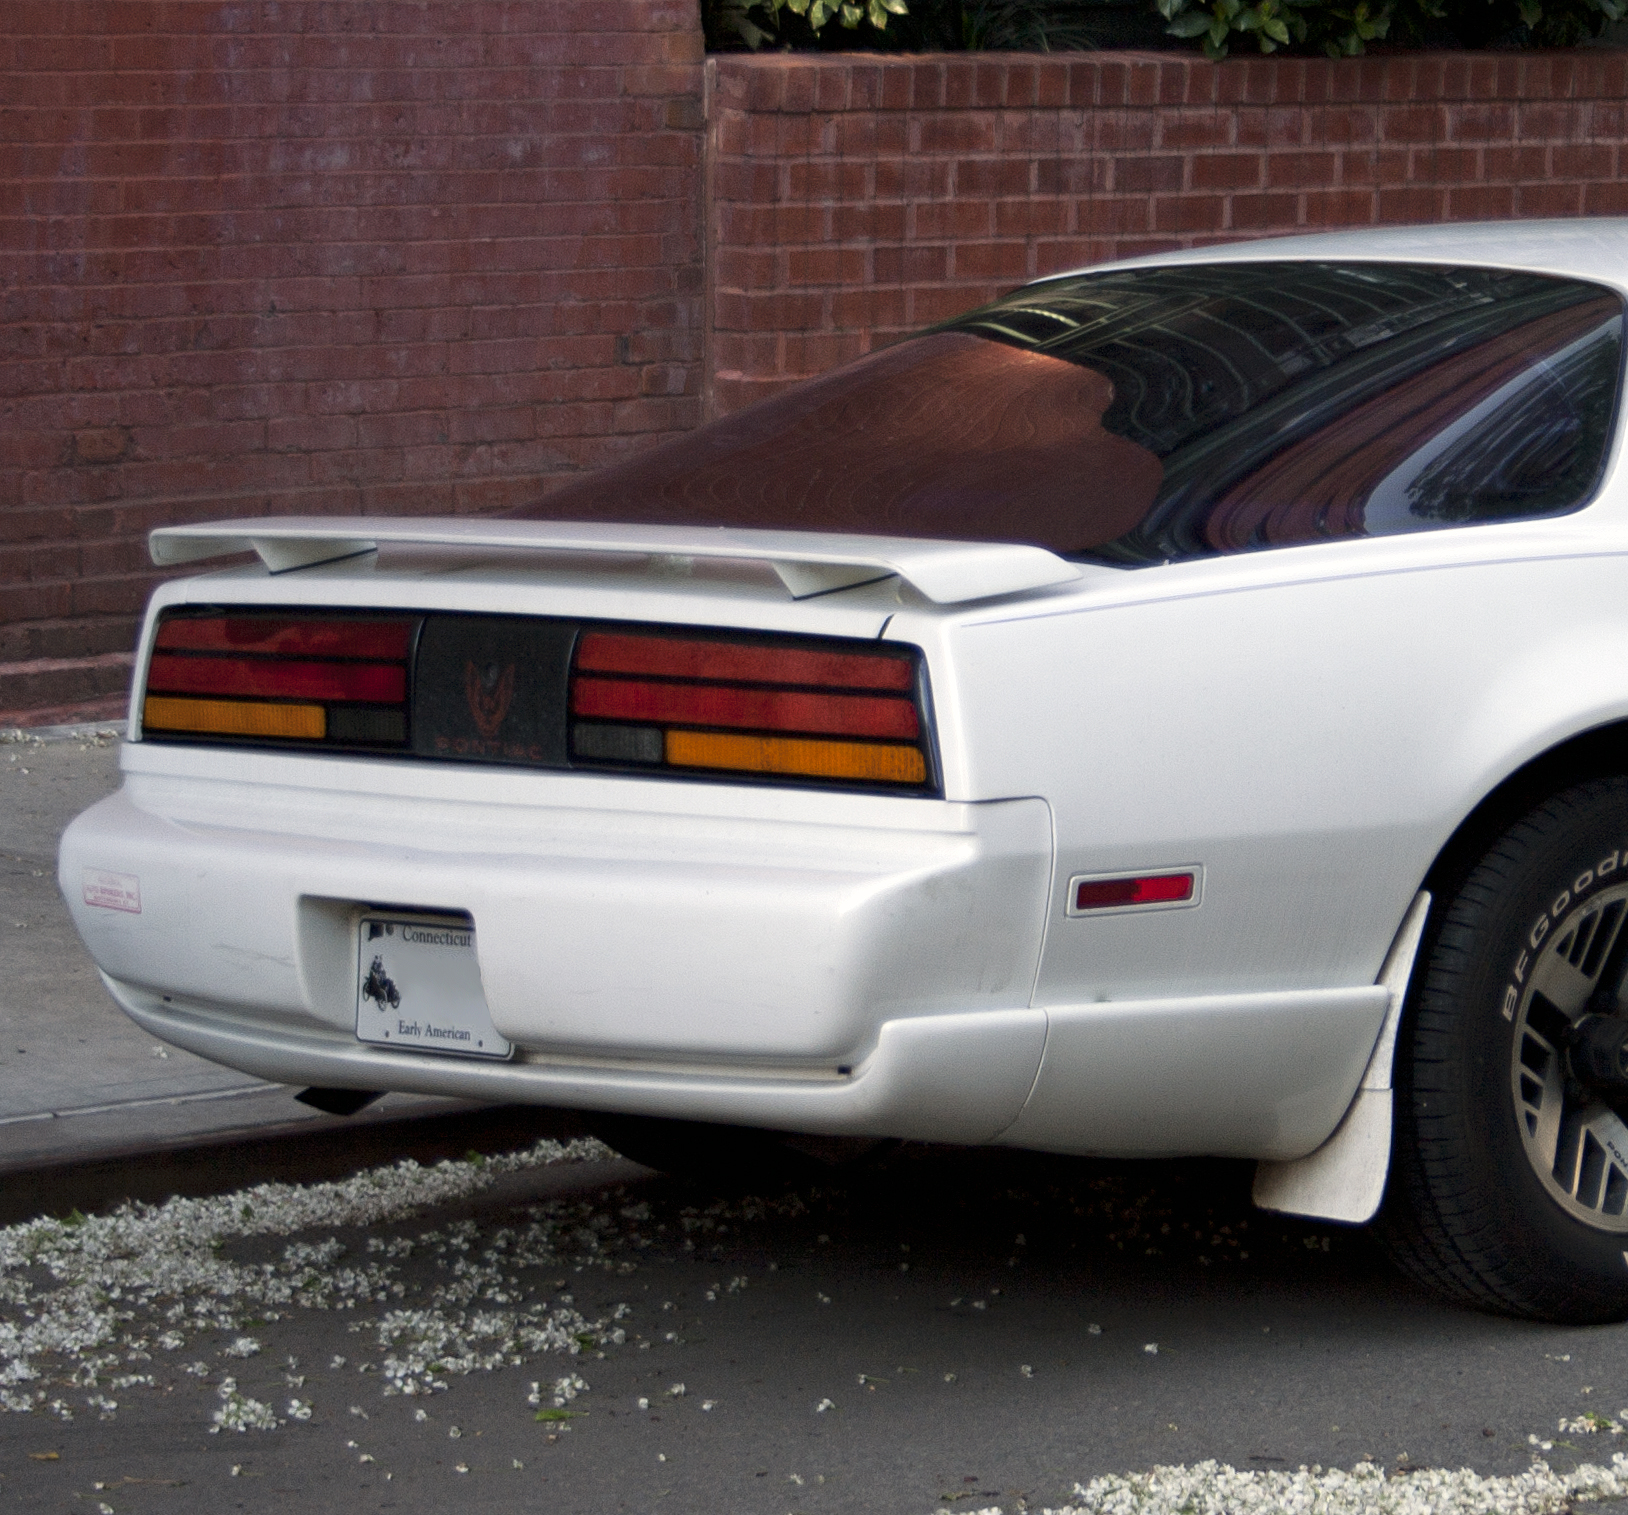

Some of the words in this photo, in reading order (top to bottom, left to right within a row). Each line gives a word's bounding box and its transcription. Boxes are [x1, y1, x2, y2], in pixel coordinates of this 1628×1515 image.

[435, 736, 543, 760] PONTIAC
[402, 925, 472, 948] Connecticut
[398, 1020, 422, 1038] Early
[425, 1023, 471, 1041] American
